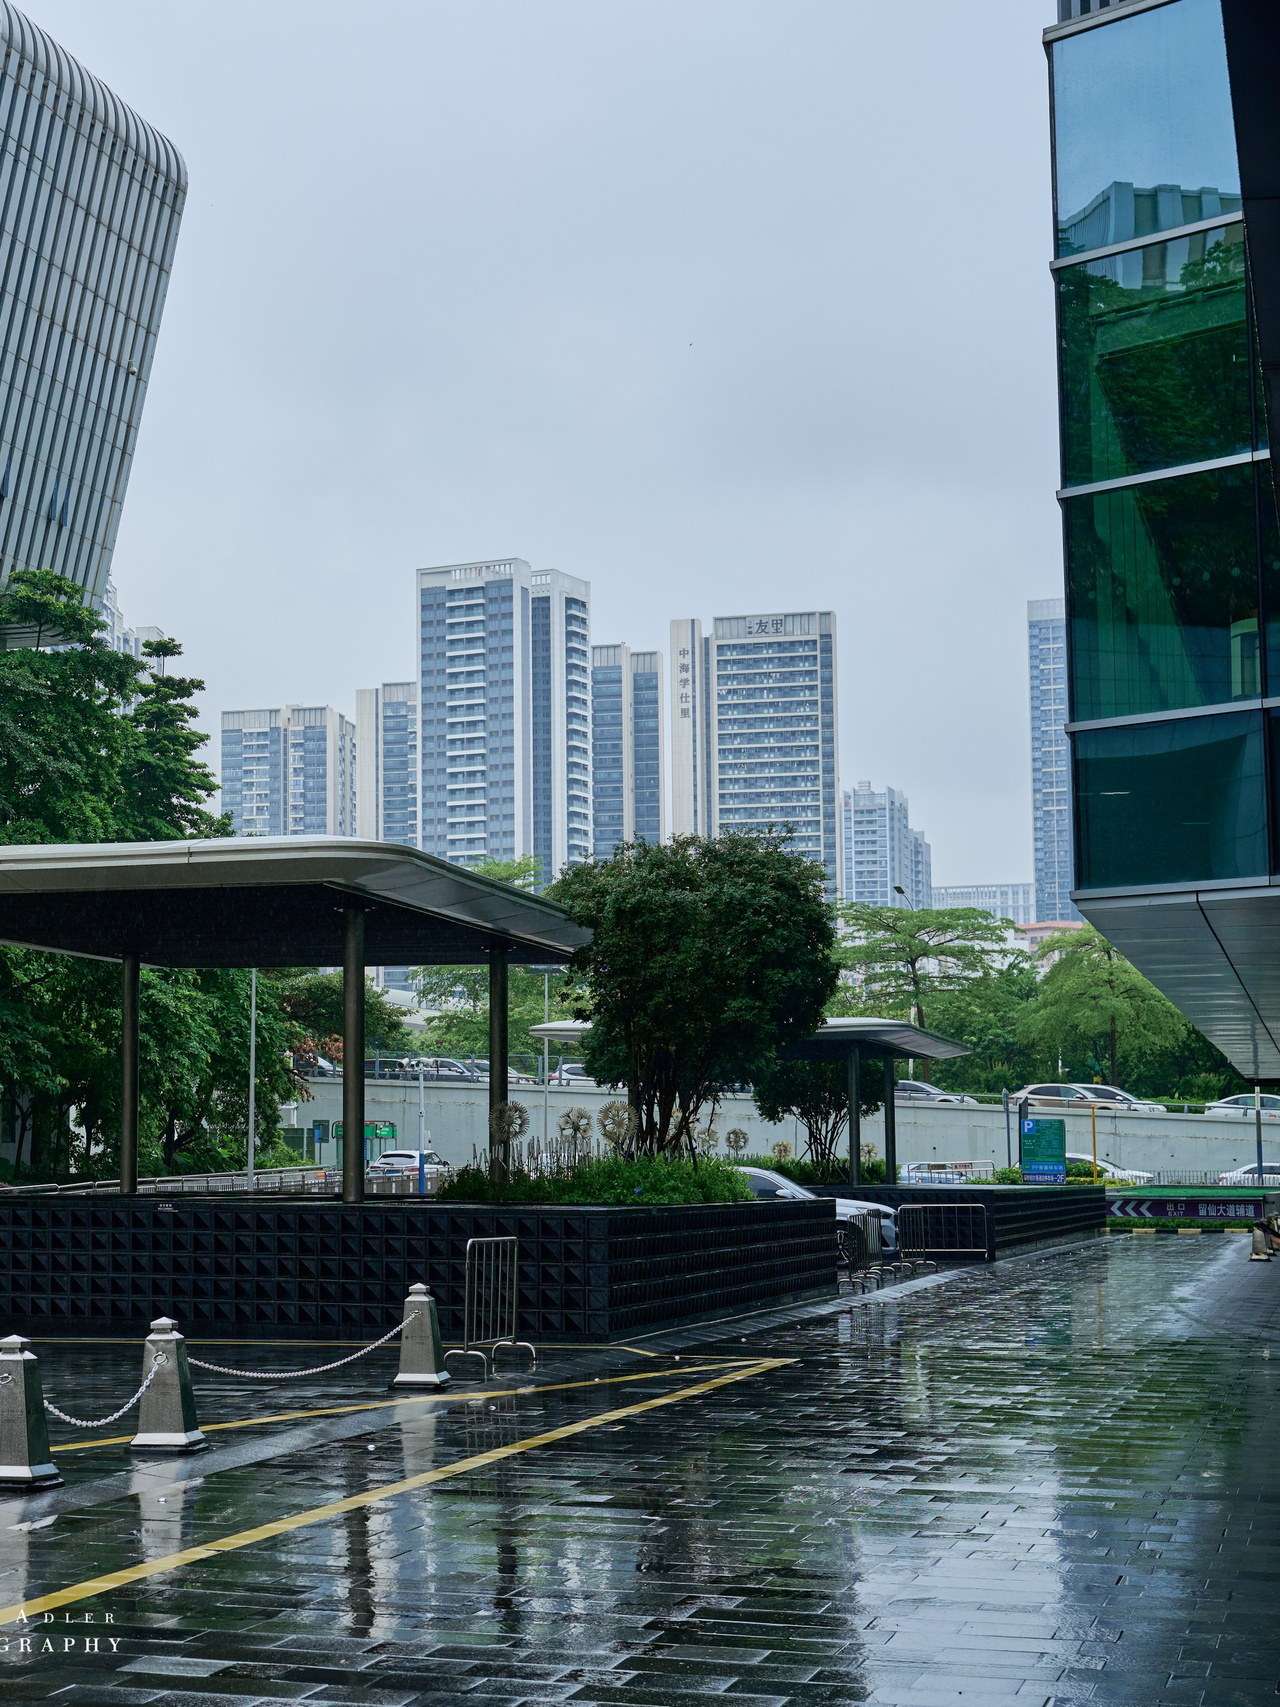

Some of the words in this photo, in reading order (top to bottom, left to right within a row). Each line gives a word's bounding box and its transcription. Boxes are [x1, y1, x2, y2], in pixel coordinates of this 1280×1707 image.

[755, 618, 783, 635] 友里
[679, 647, 691, 719] 中海学仕里
[1024, 1120, 1033, 1133] P
[1166, 1202, 1185, 1211] 出口
[1198, 1203, 1255, 1217] 留仙大道辅道
